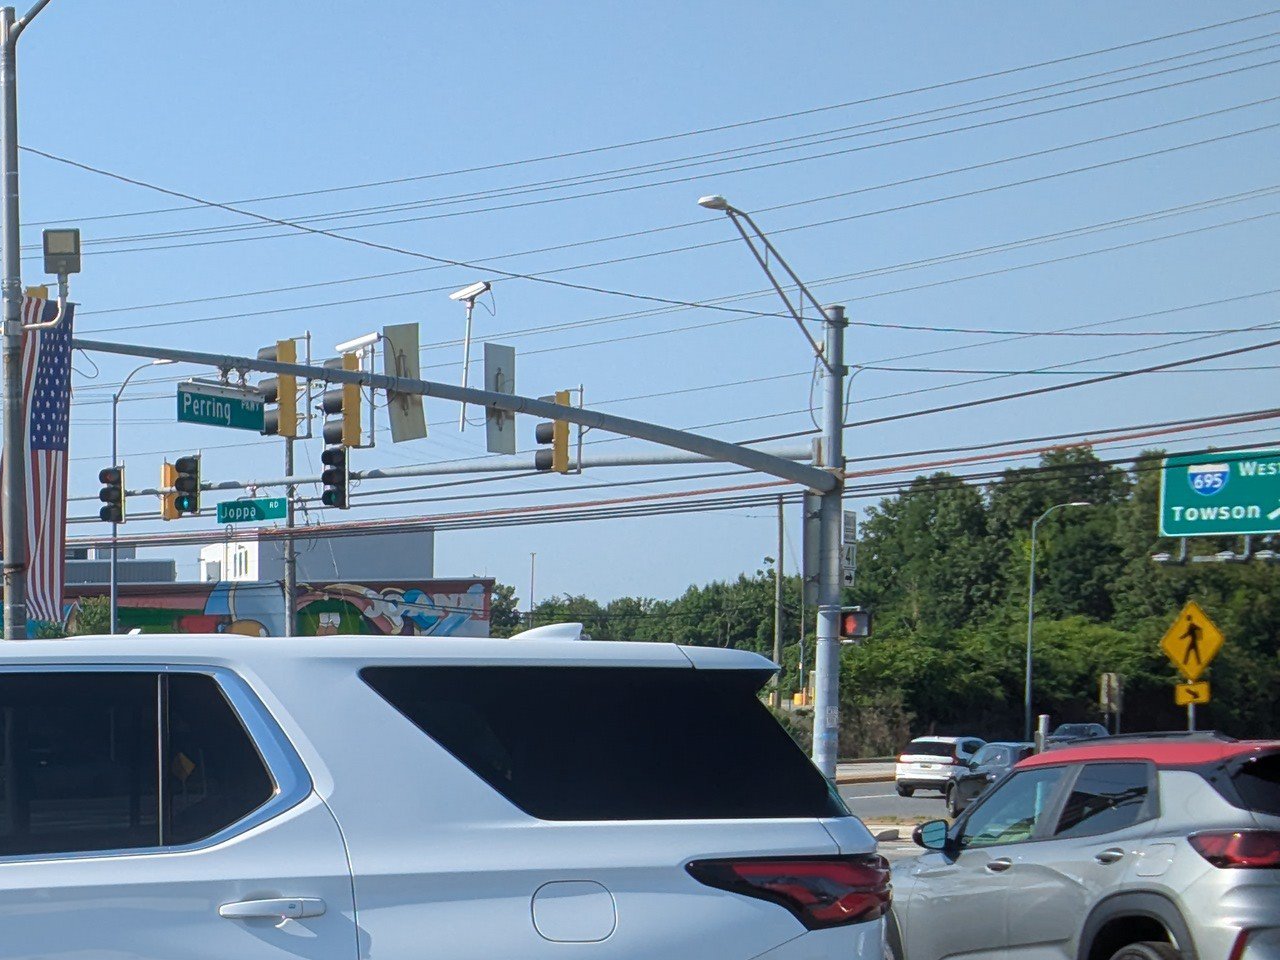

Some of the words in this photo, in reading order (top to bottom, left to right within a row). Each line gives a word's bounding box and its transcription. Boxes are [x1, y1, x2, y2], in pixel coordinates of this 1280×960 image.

[183, 393, 231, 425] Perring
[1193, 473, 1223, 489] 695
[220, 506, 256, 520] Joppa
[269, 501, 279, 509] RD
